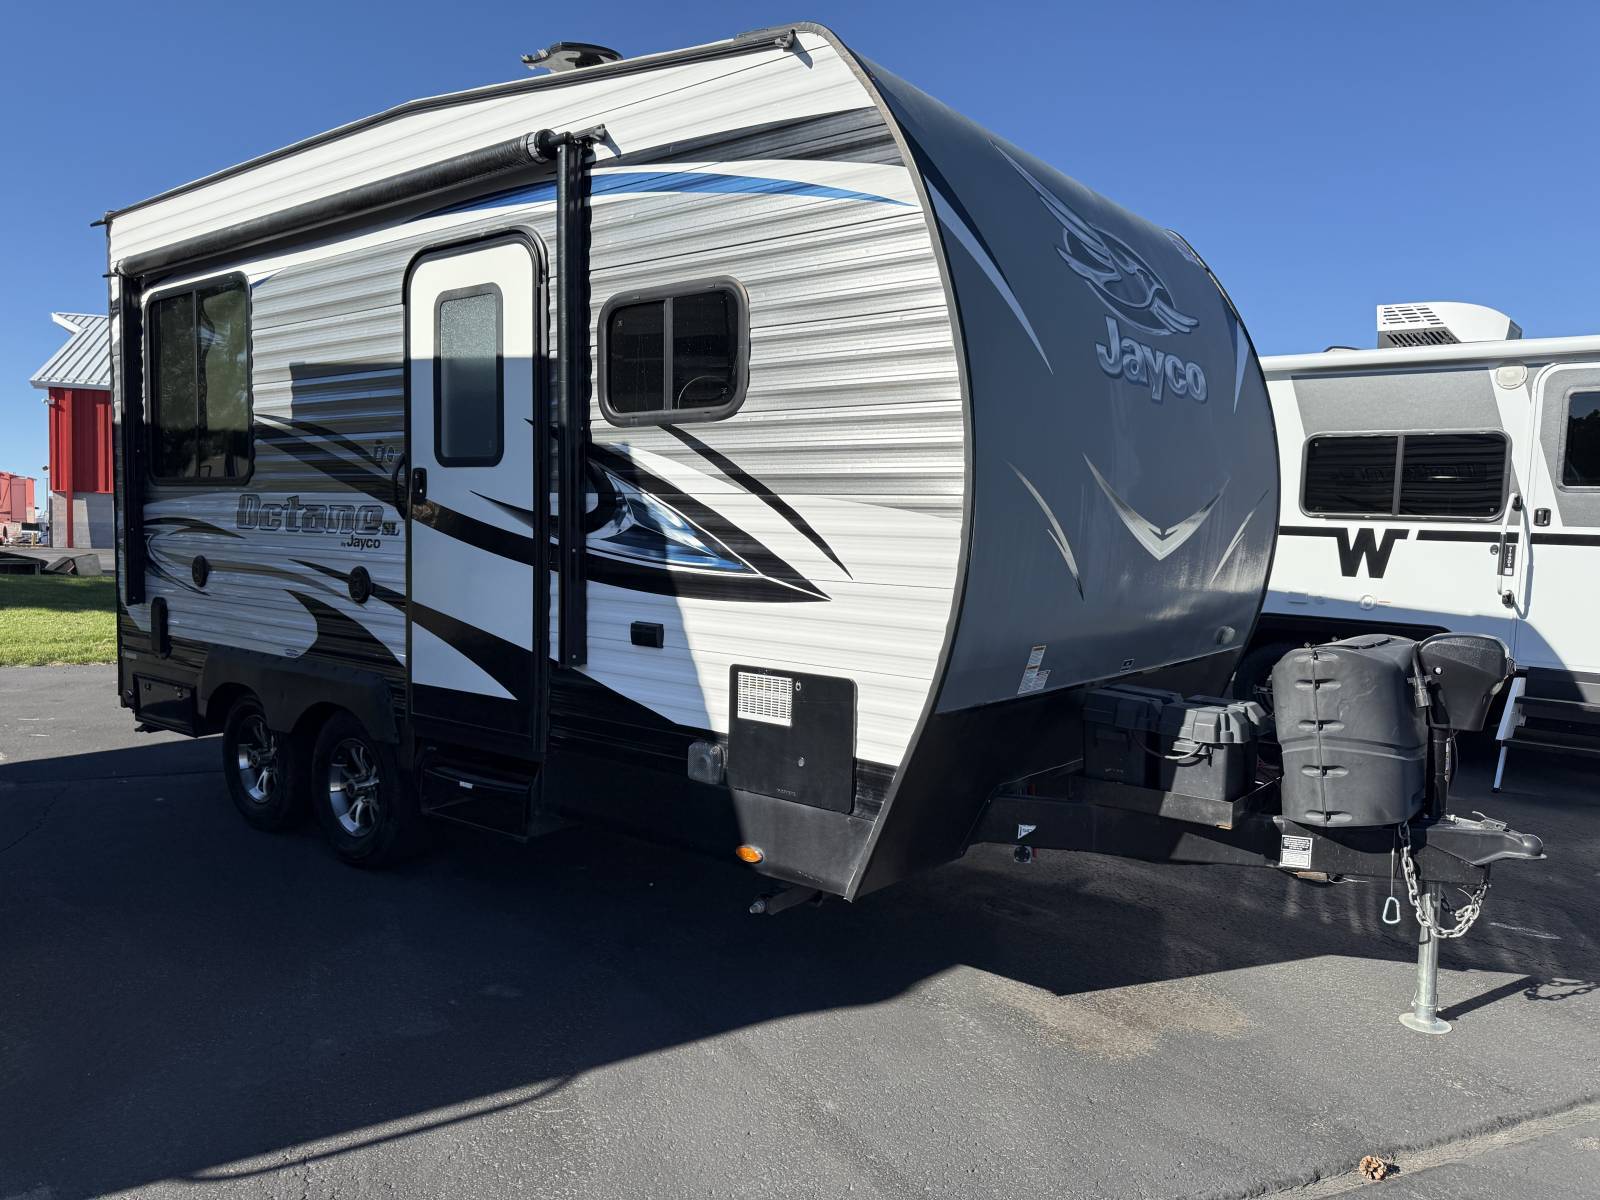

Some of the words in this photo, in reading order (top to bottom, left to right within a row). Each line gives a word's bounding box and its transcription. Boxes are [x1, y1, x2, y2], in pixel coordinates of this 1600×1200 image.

[1095, 314, 1208, 404] Jayco
[236, 493, 384, 535] Octane
[381, 521, 400, 536] SL
[347, 534, 381, 551] Jayco
[1336, 526, 1410, 579] W
